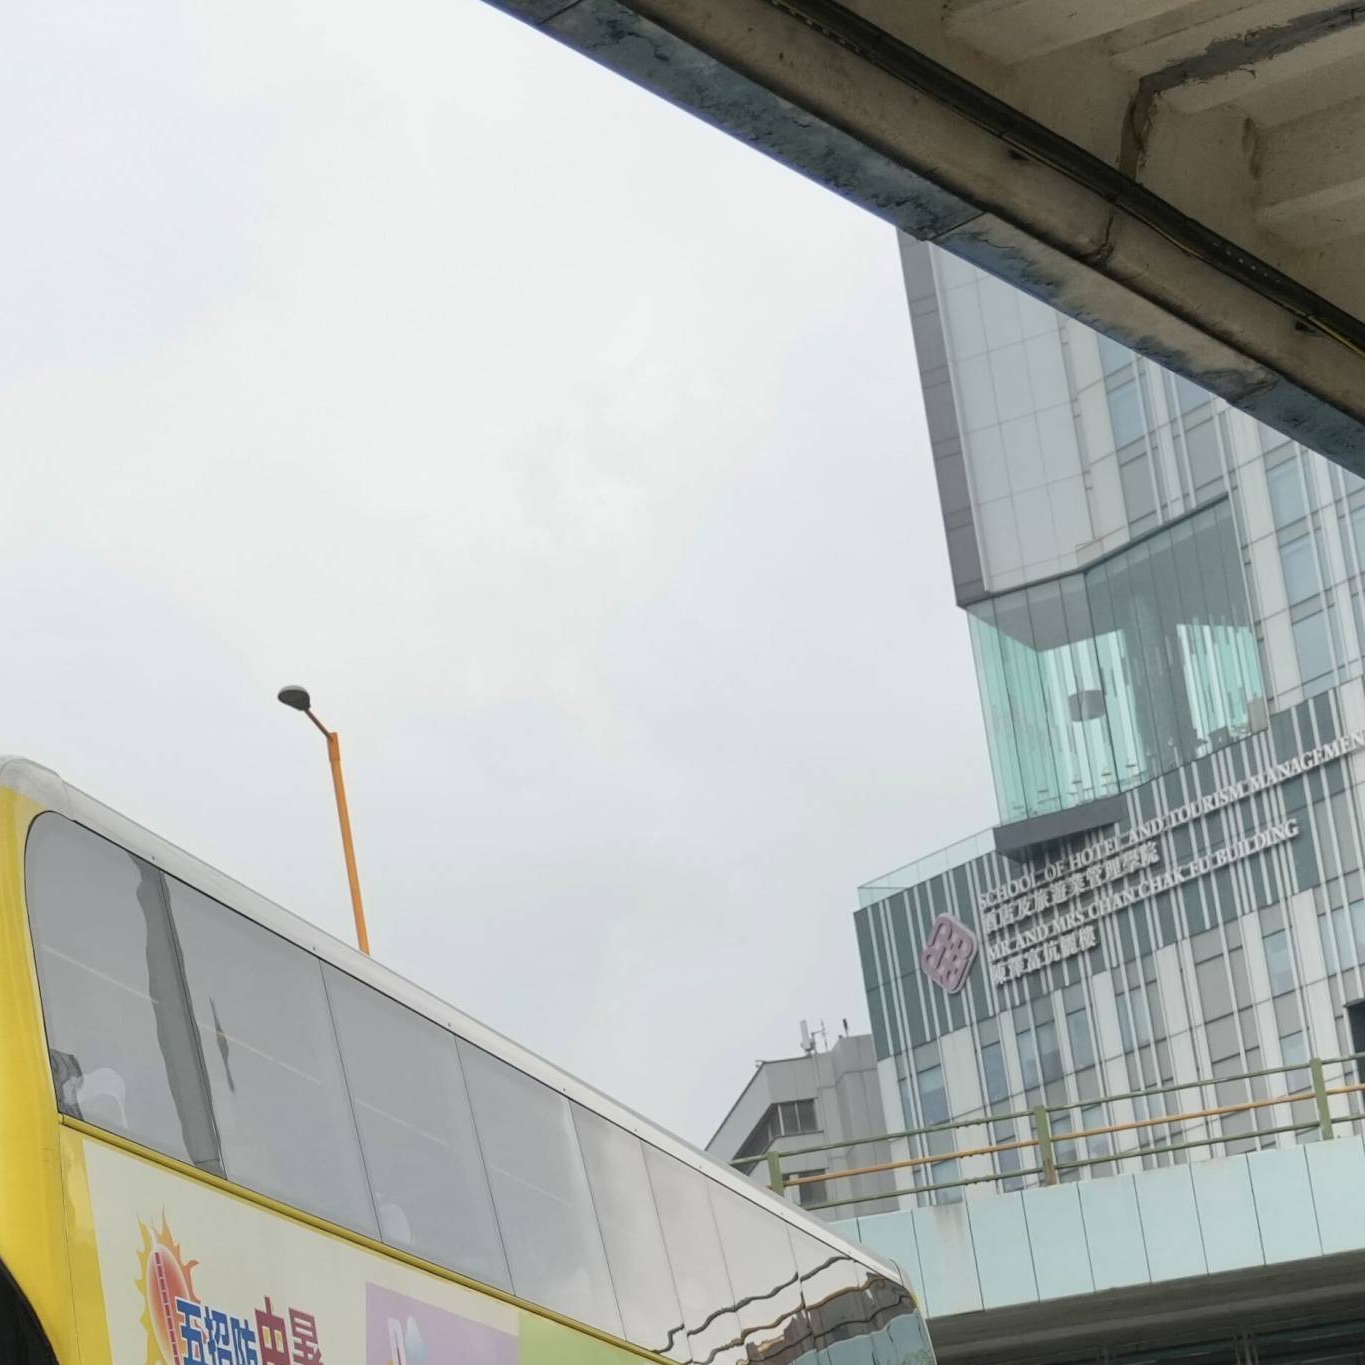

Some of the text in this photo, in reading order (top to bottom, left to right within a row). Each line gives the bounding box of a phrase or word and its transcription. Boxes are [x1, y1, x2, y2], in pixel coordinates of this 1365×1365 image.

[979, 873, 1037, 909] SCHOOL
[1044, 861, 1066, 881] OF
[1070, 839, 1119, 870] HOTEL
[1128, 818, 1164, 845] AND
[1169, 781, 1249, 828] TOURISM
[988, 818, 1299, 962] MR AND MRS CHAN CHAK FU BUILDING
